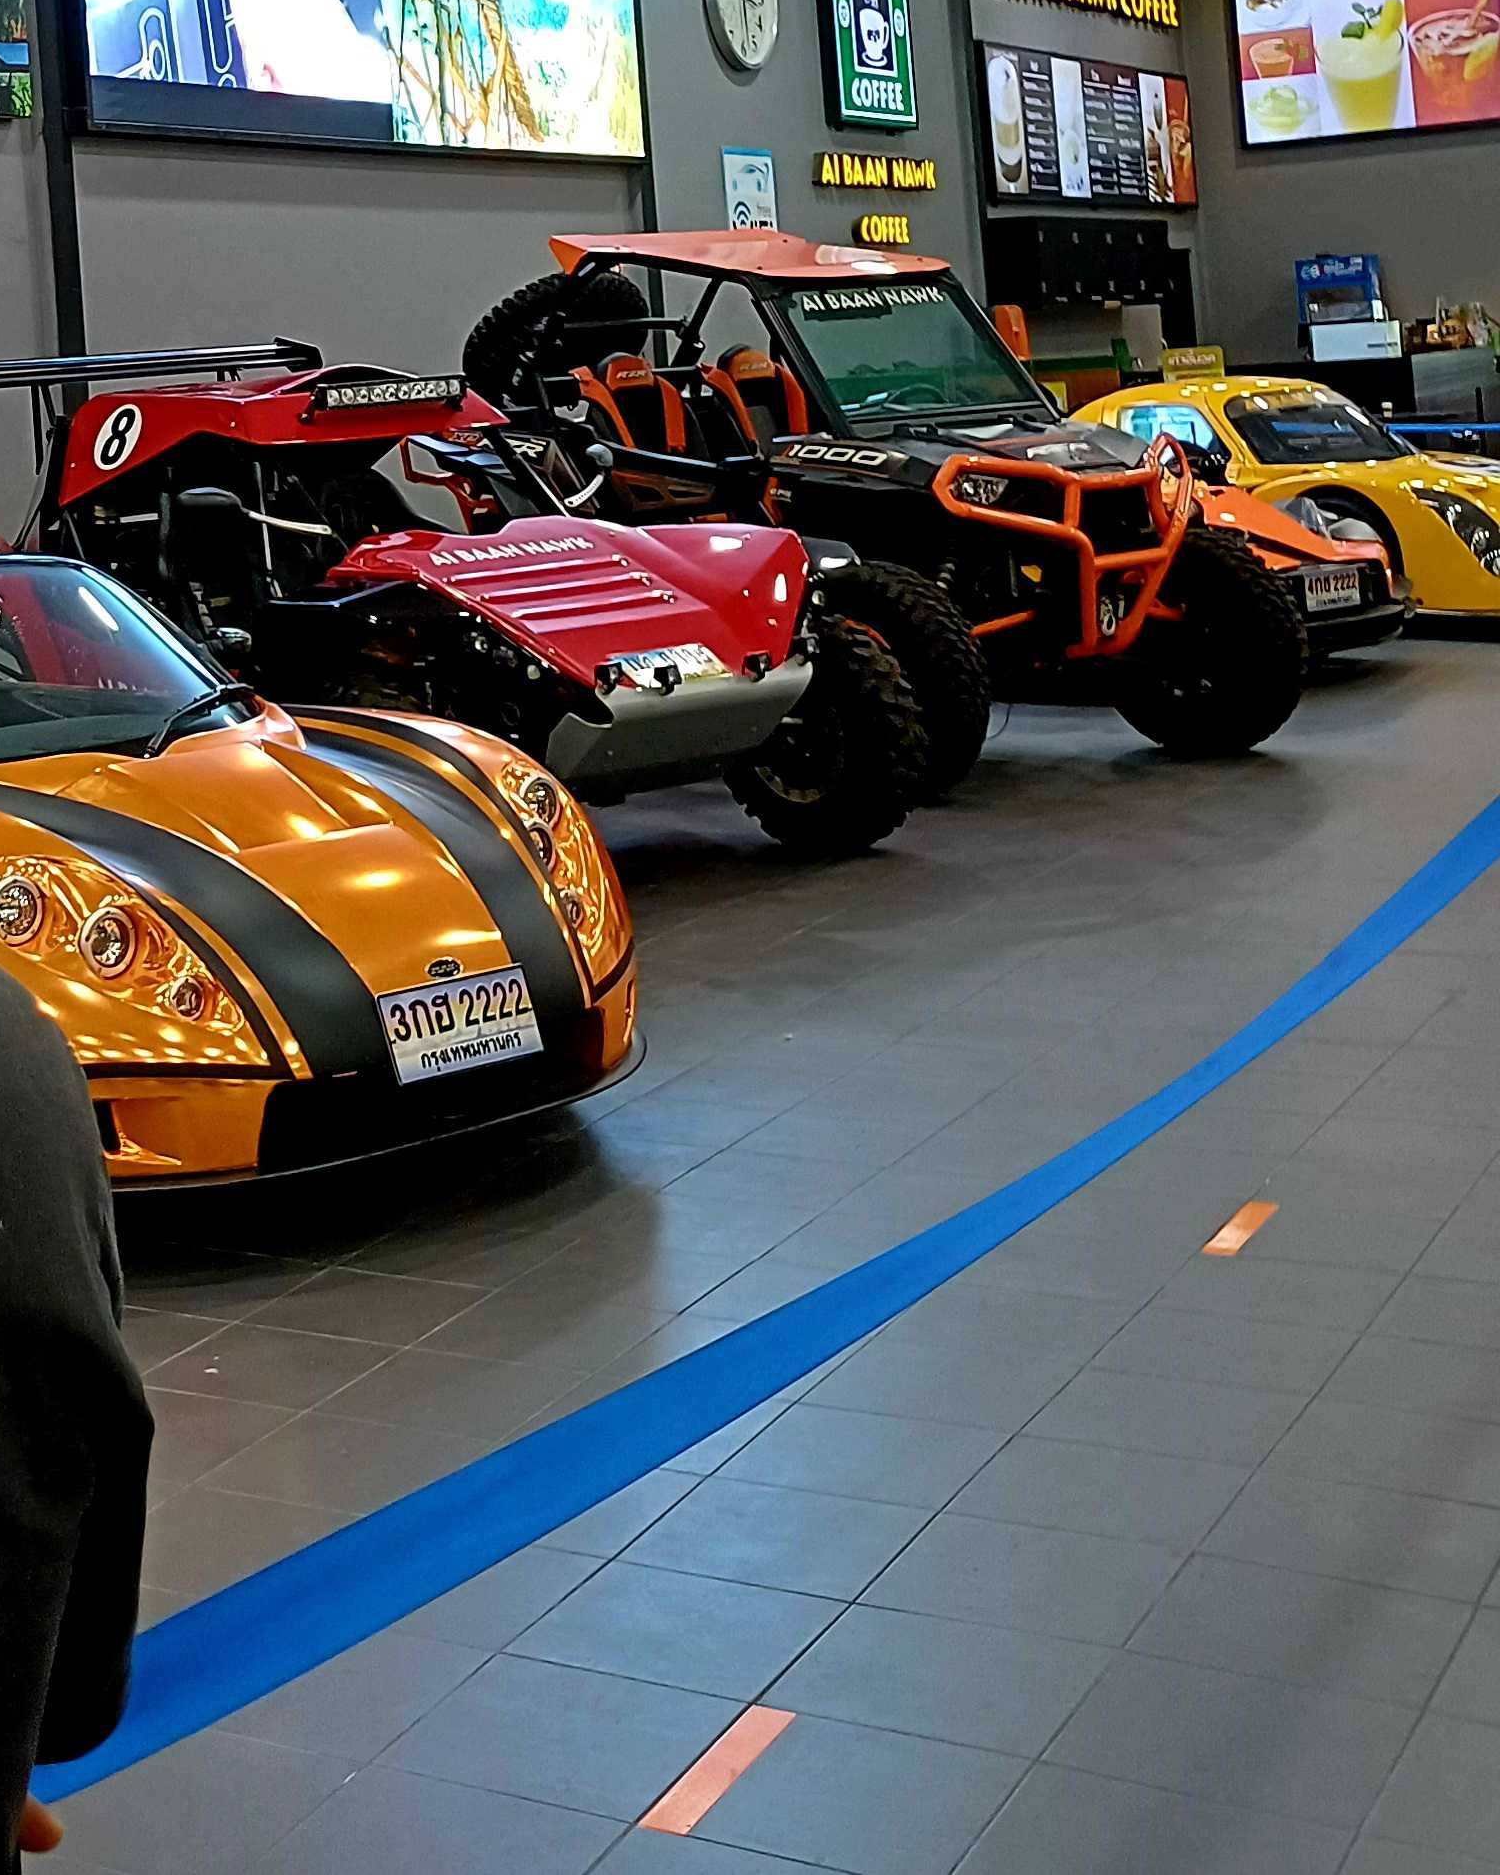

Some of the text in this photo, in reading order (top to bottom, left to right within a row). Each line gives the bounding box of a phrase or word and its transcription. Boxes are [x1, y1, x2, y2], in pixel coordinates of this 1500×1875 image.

[851, 77, 905, 112] COFFEE
[821, 153, 937, 190] AI BAAN NAWK
[860, 214, 910, 244] COFFEE
[802, 285, 945, 312] AI BAAN NAWK
[100, 407, 136, 466] 8
[788, 443, 888, 466] 1000
[458, 977, 533, 1028] 2222
[419, 1031, 523, 1072] กรุงเทพมหานคร
